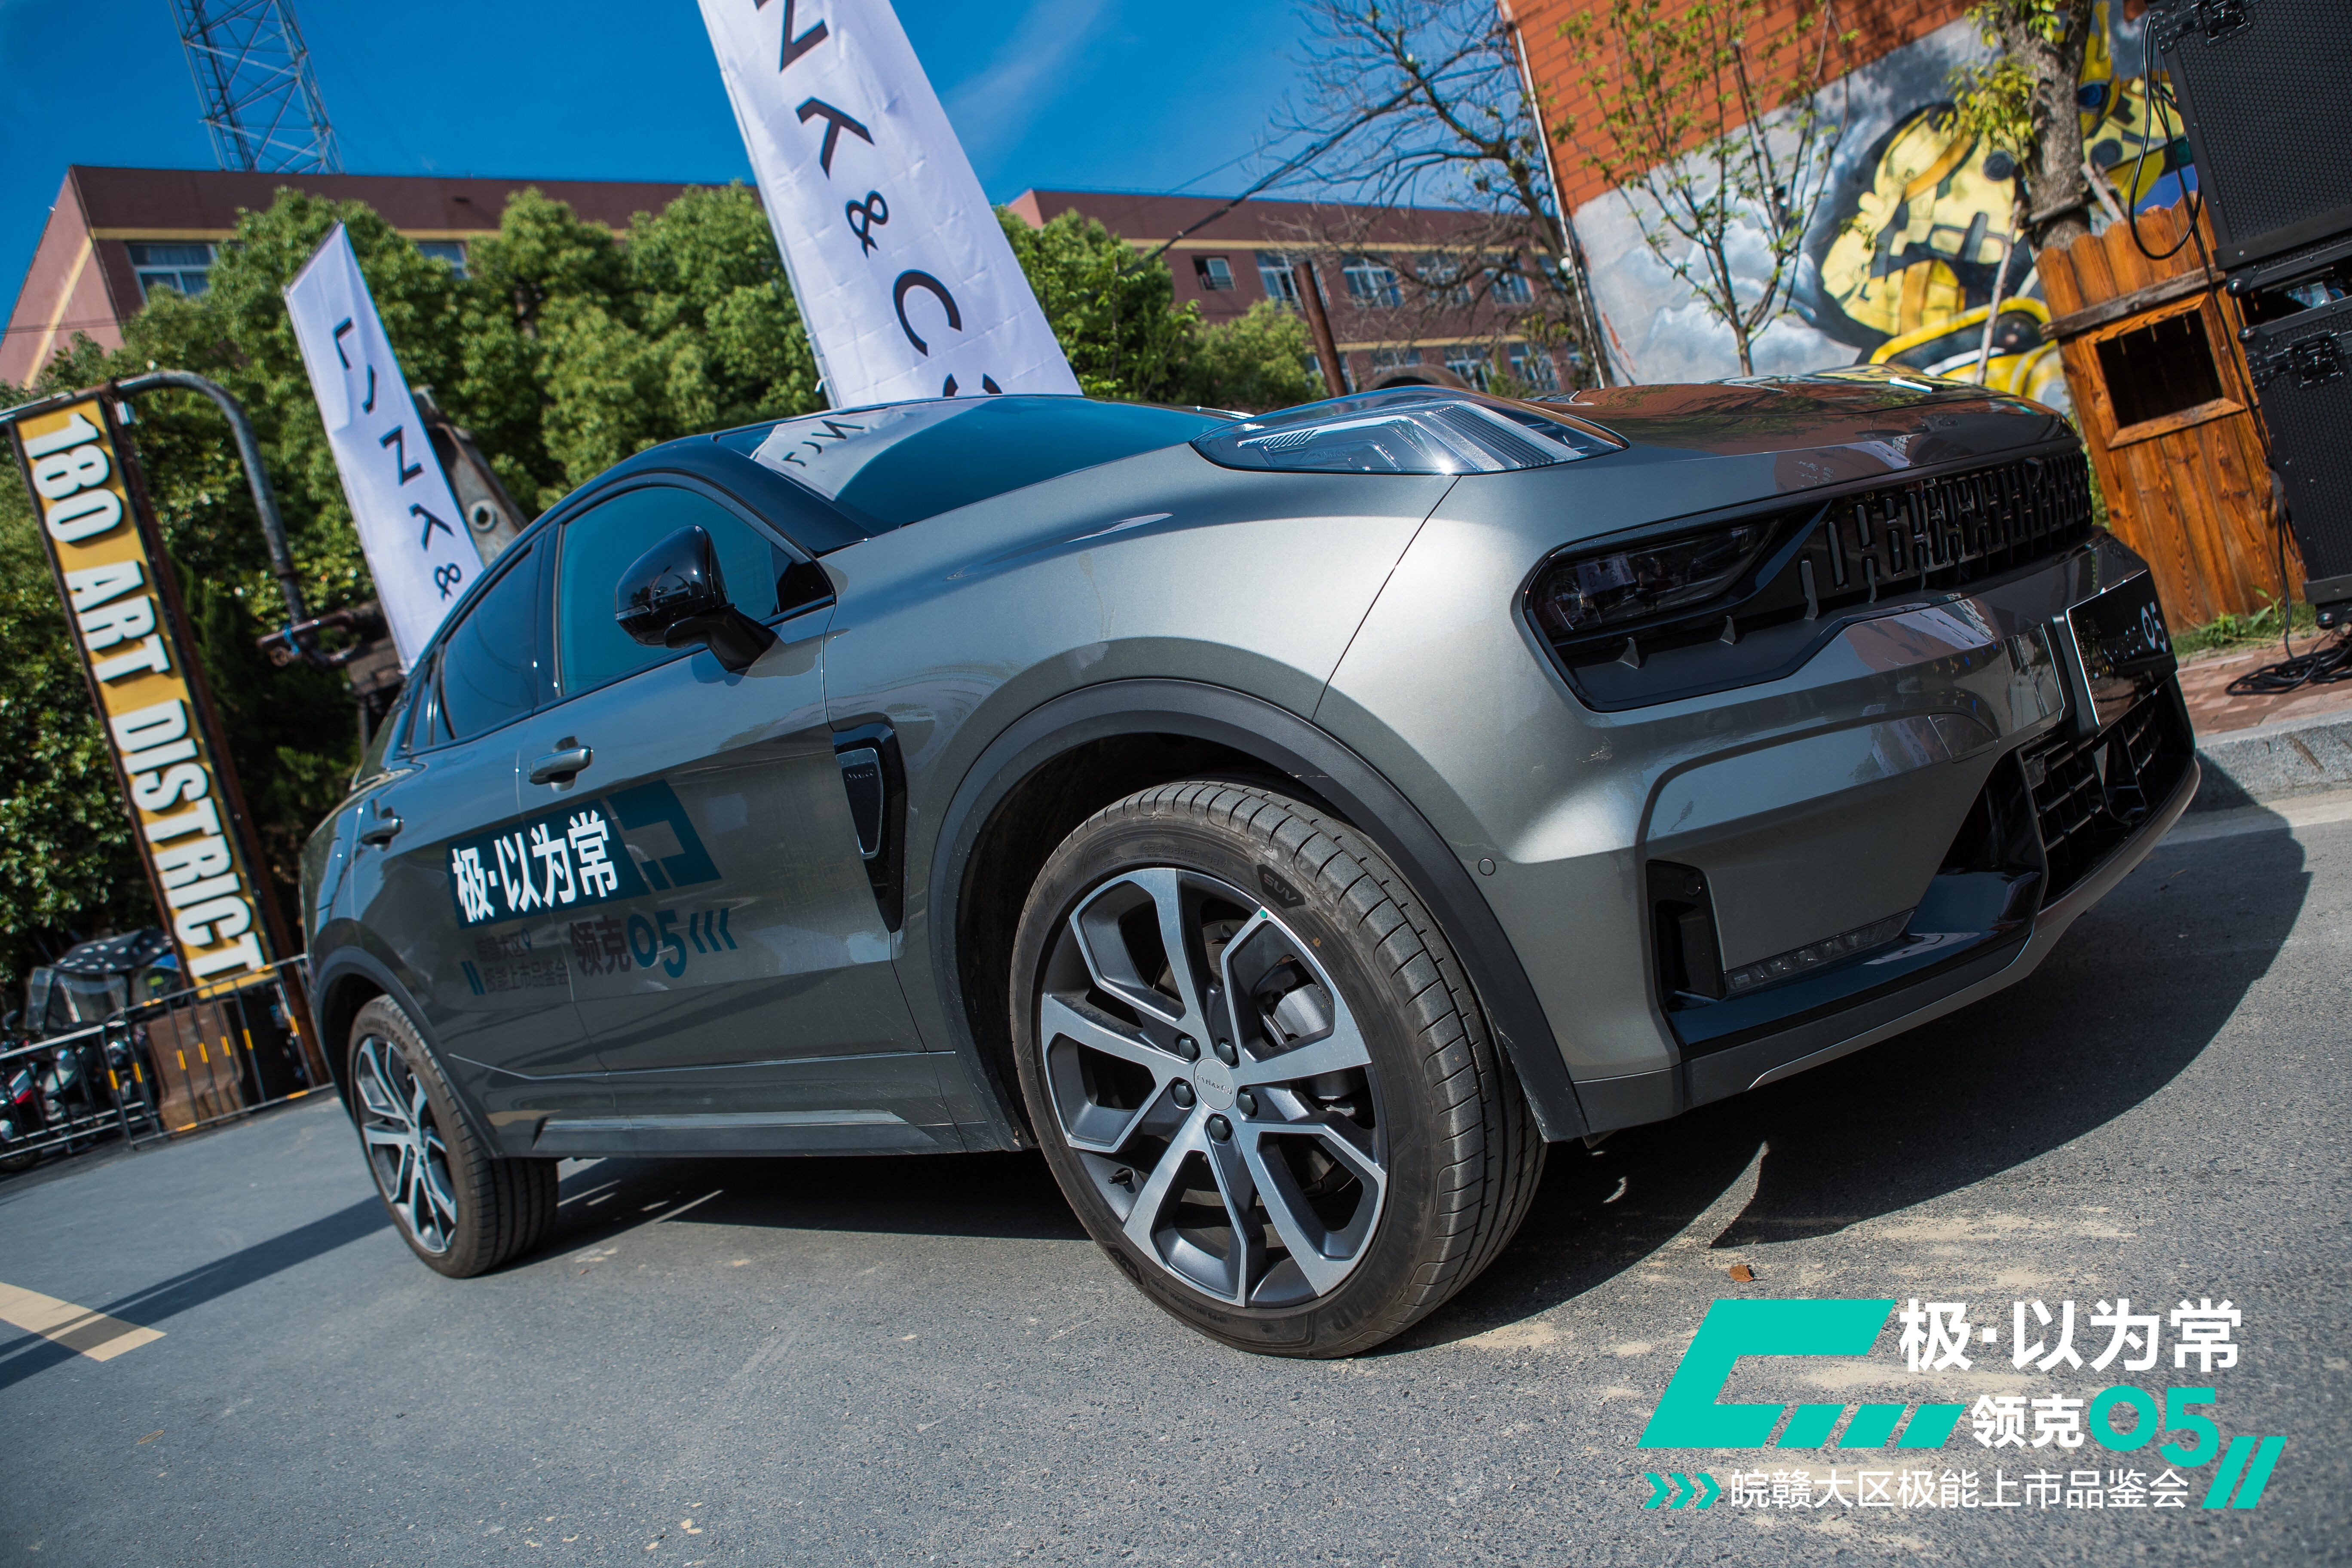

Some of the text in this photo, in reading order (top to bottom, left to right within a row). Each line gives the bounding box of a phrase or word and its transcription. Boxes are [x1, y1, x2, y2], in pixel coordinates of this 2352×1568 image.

[2141, 601, 2167, 653] 05
[24, 412, 267, 979] 180 ART DISTRICT
[452, 810, 619, 922] 极·以为常
[1264, 873, 1297, 902] SUV
